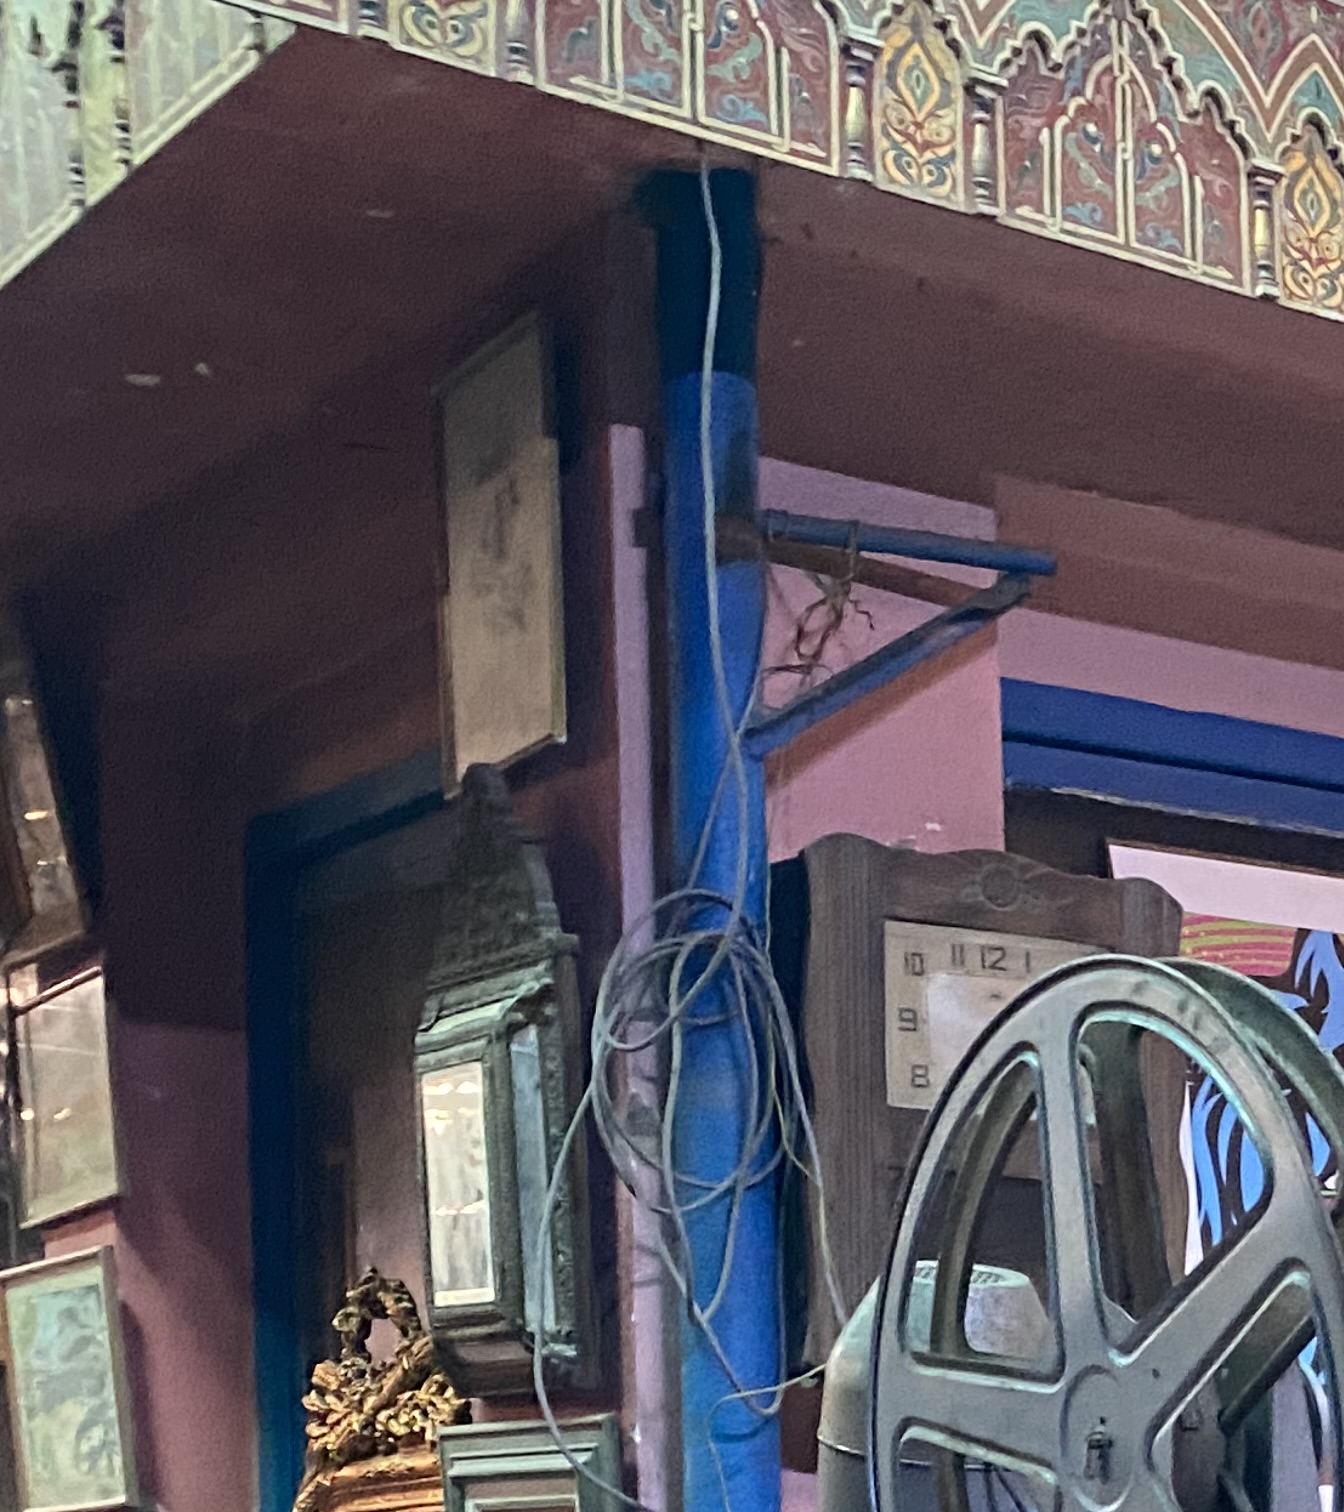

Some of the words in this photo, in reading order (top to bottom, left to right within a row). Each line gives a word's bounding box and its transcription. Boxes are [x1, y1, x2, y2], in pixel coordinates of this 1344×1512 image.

[903, 951, 925, 977] 10
[980, 947, 1007, 971] 12
[898, 1007, 918, 1032] 9
[911, 1064, 930, 1089] 8
